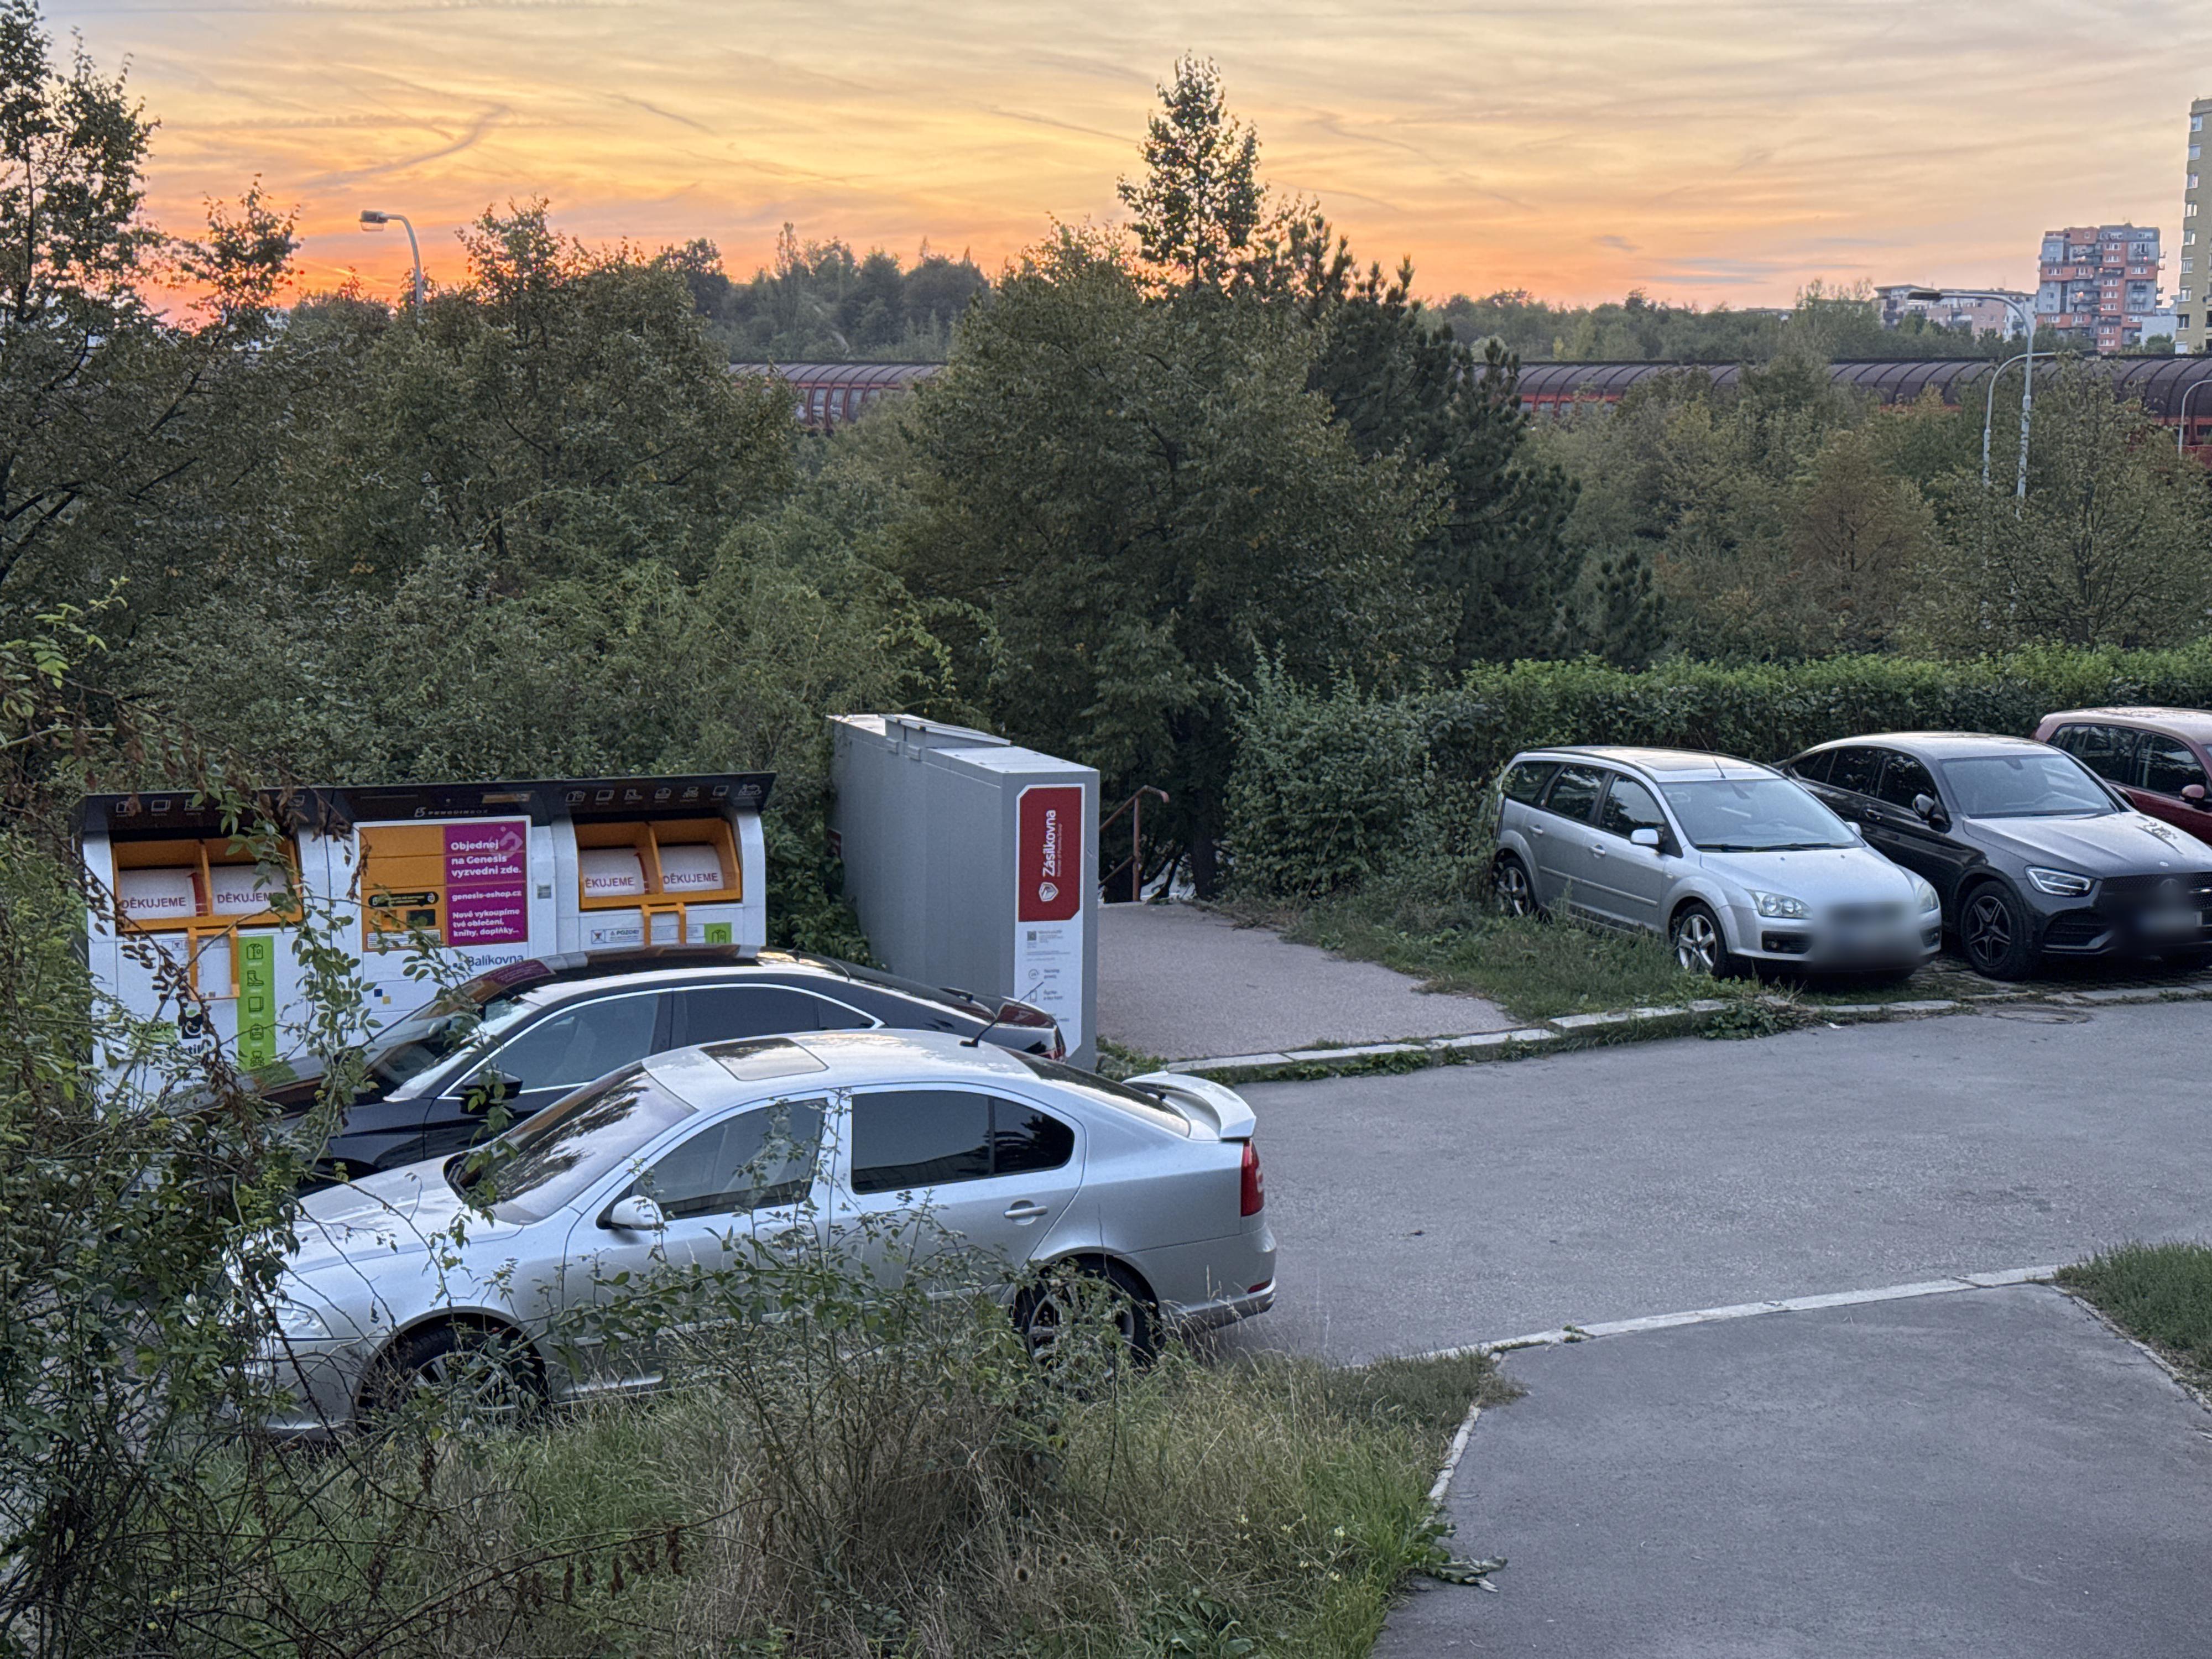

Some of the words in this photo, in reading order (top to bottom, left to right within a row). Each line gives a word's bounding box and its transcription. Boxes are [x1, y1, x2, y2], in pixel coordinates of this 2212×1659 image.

[451, 839, 499, 852] Objednej
[1042, 810, 1056, 877] Zásilkovna
[466, 853, 507, 864] Genesis
[451, 865, 498, 879] vyzvedni
[500, 865, 521, 874] zde.
[585, 877, 635, 888] ĚKUJEME
[662, 873, 718, 885] DĚKUJEME
[217, 892, 279, 904] DĚKUJEM
[452, 890, 522, 902] genesis-eshop.cz
[121, 897, 187, 909] DĚKUJEME
[474, 908, 520, 919] vykoupíme
[453, 929, 478, 937] knihy,
[468, 954, 524, 967] Balíkovna
